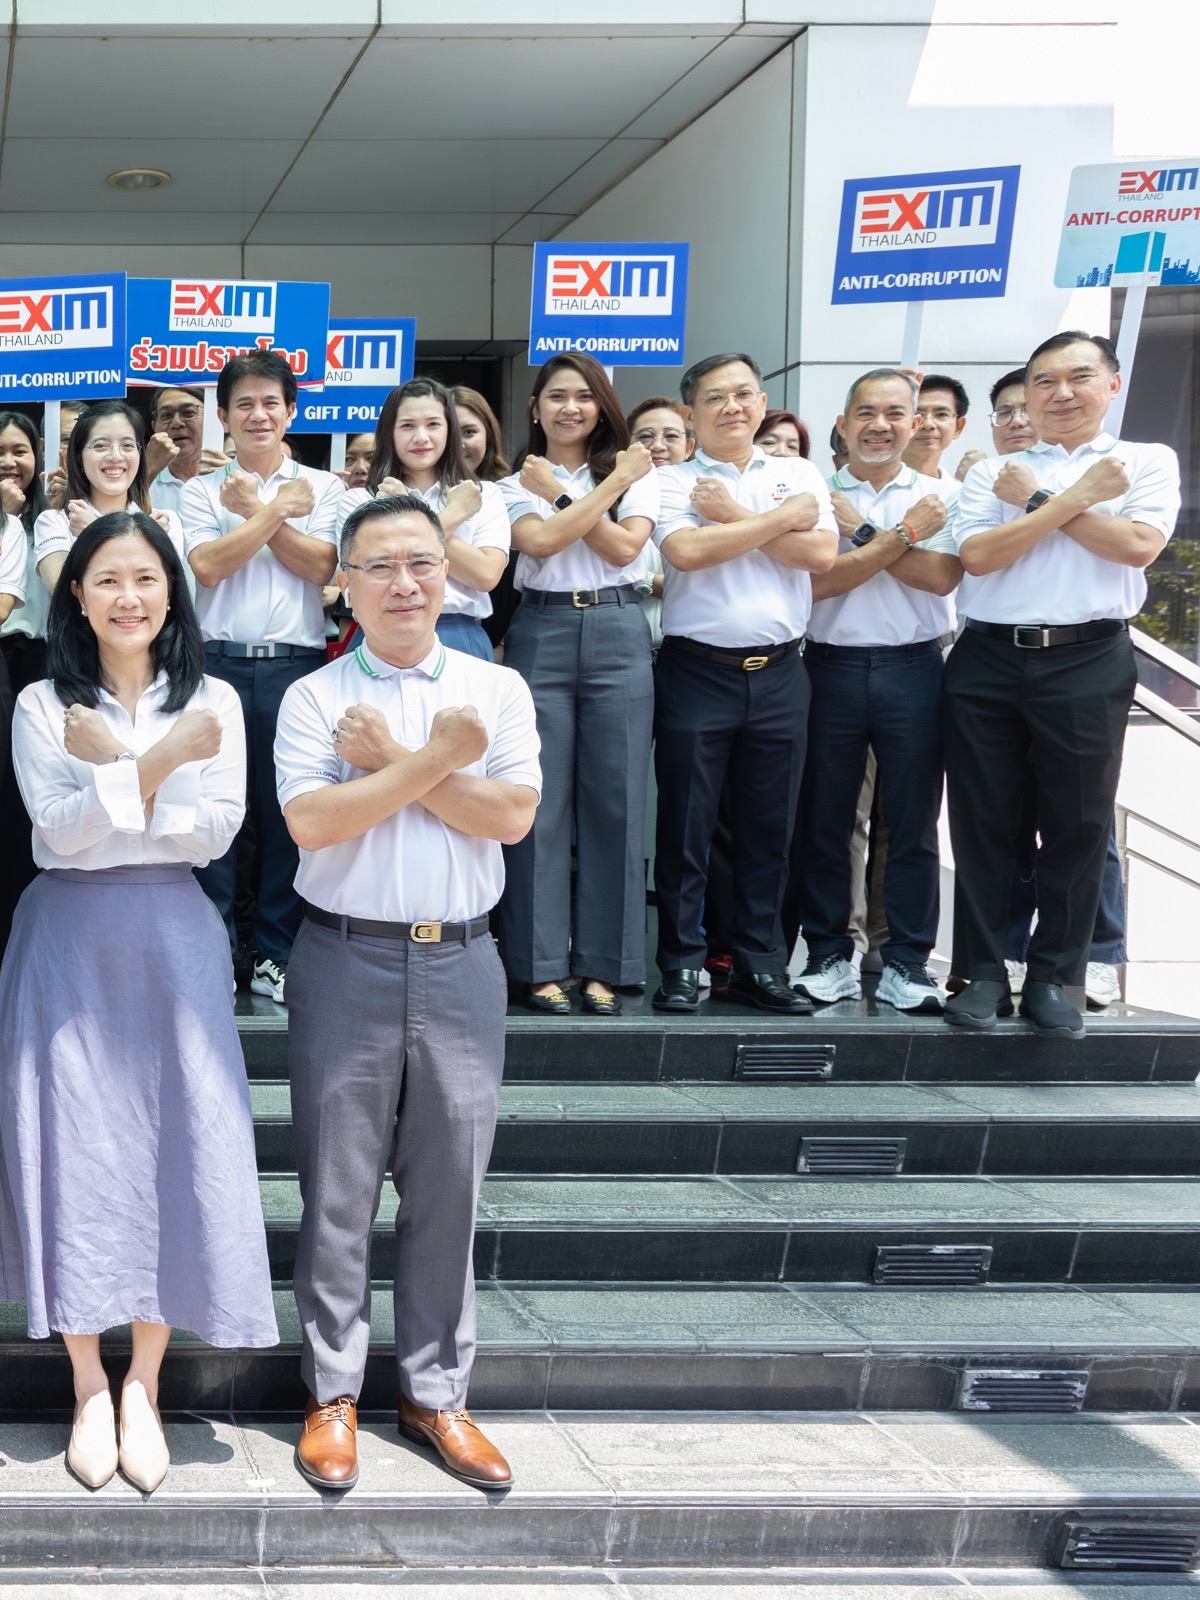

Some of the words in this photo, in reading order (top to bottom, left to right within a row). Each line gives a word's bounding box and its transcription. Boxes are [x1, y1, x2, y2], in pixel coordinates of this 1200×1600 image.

[1118, 193, 1164, 203] THAILAND
[860, 231, 937, 247] THAILAND
[839, 268, 1002, 290] ANTI-CORRUPTION
[552, 299, 621, 310] THAILAND
[174, 317, 232, 328] THAILAND
[536, 337, 679, 352] ANTI-CORRUPTION
[304, 406, 341, 420] GIFT
